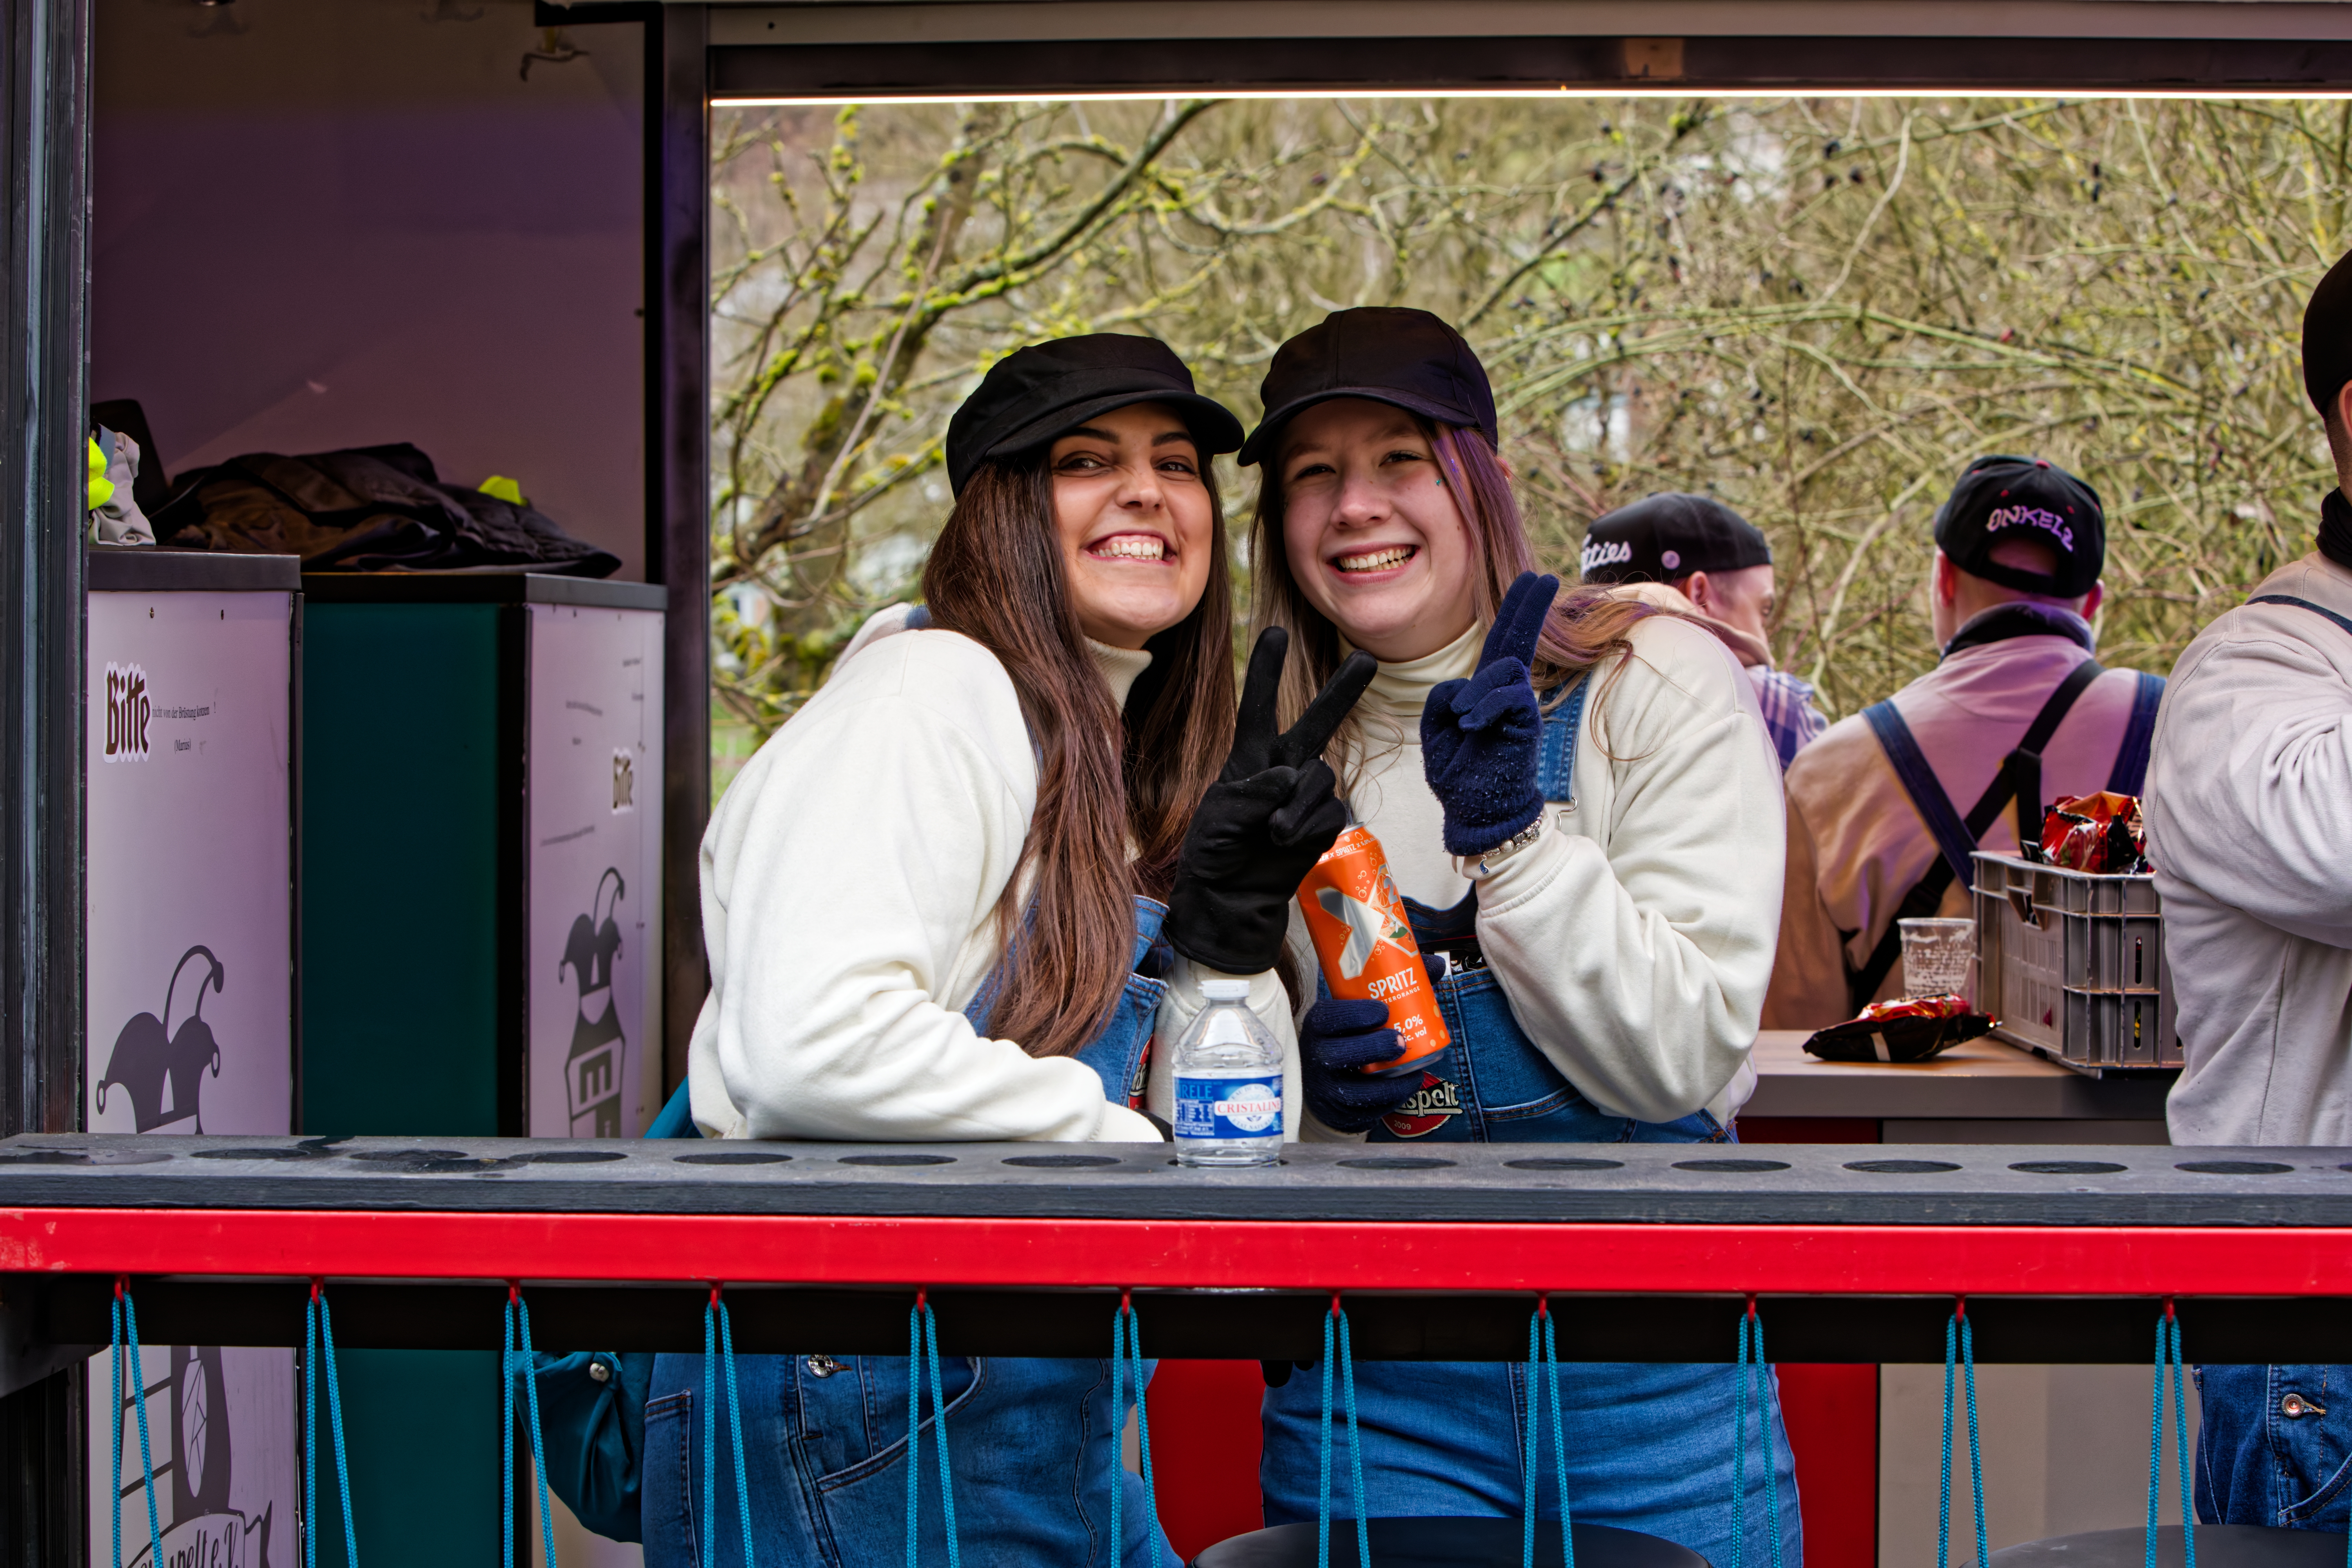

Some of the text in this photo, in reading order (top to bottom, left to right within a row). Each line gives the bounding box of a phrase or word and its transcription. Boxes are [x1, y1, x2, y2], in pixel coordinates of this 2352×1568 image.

[105, 670, 150, 755] Bitte
[152, 706, 162, 717] nicht
[1336, 844, 1357, 856] SPRITZ
[1368, 967, 1417, 999] SPRITZ
[1394, 1014, 1423, 1033] 5,0%
[1414, 1026, 1427, 1038] vol
[1394, 1120, 1411, 1130] 2009
